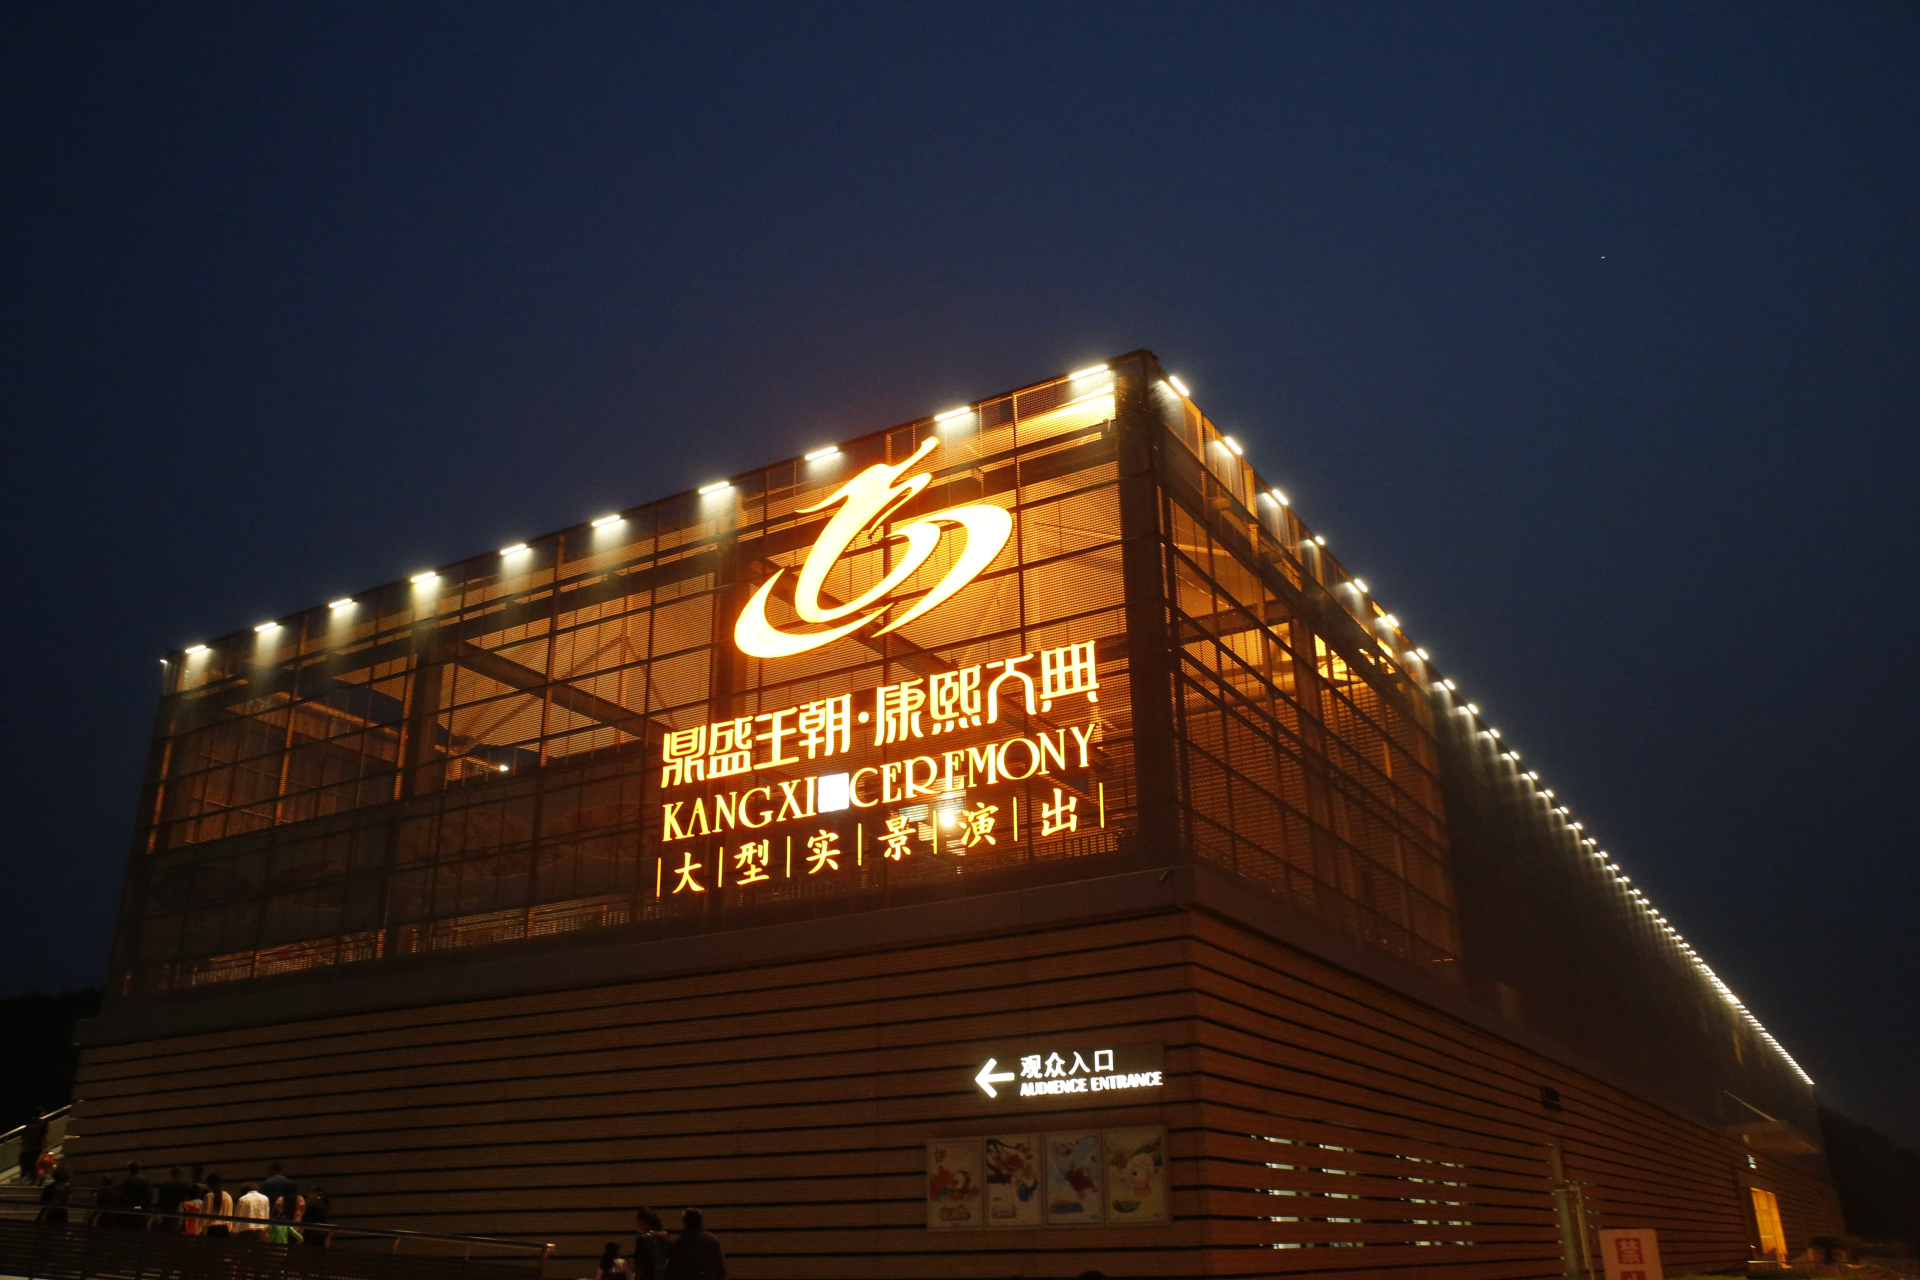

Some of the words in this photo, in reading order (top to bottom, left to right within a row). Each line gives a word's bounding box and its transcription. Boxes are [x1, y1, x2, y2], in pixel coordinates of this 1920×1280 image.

[662, 776, 818, 842] KANGXI
[849, 723, 1097, 808] CEREMONY
[1020, 1049, 1114, 1078] 观众入口
[1020, 1078, 1088, 1096] AUDIENCE
[1090, 1071, 1163, 1091] ENTRANCE
